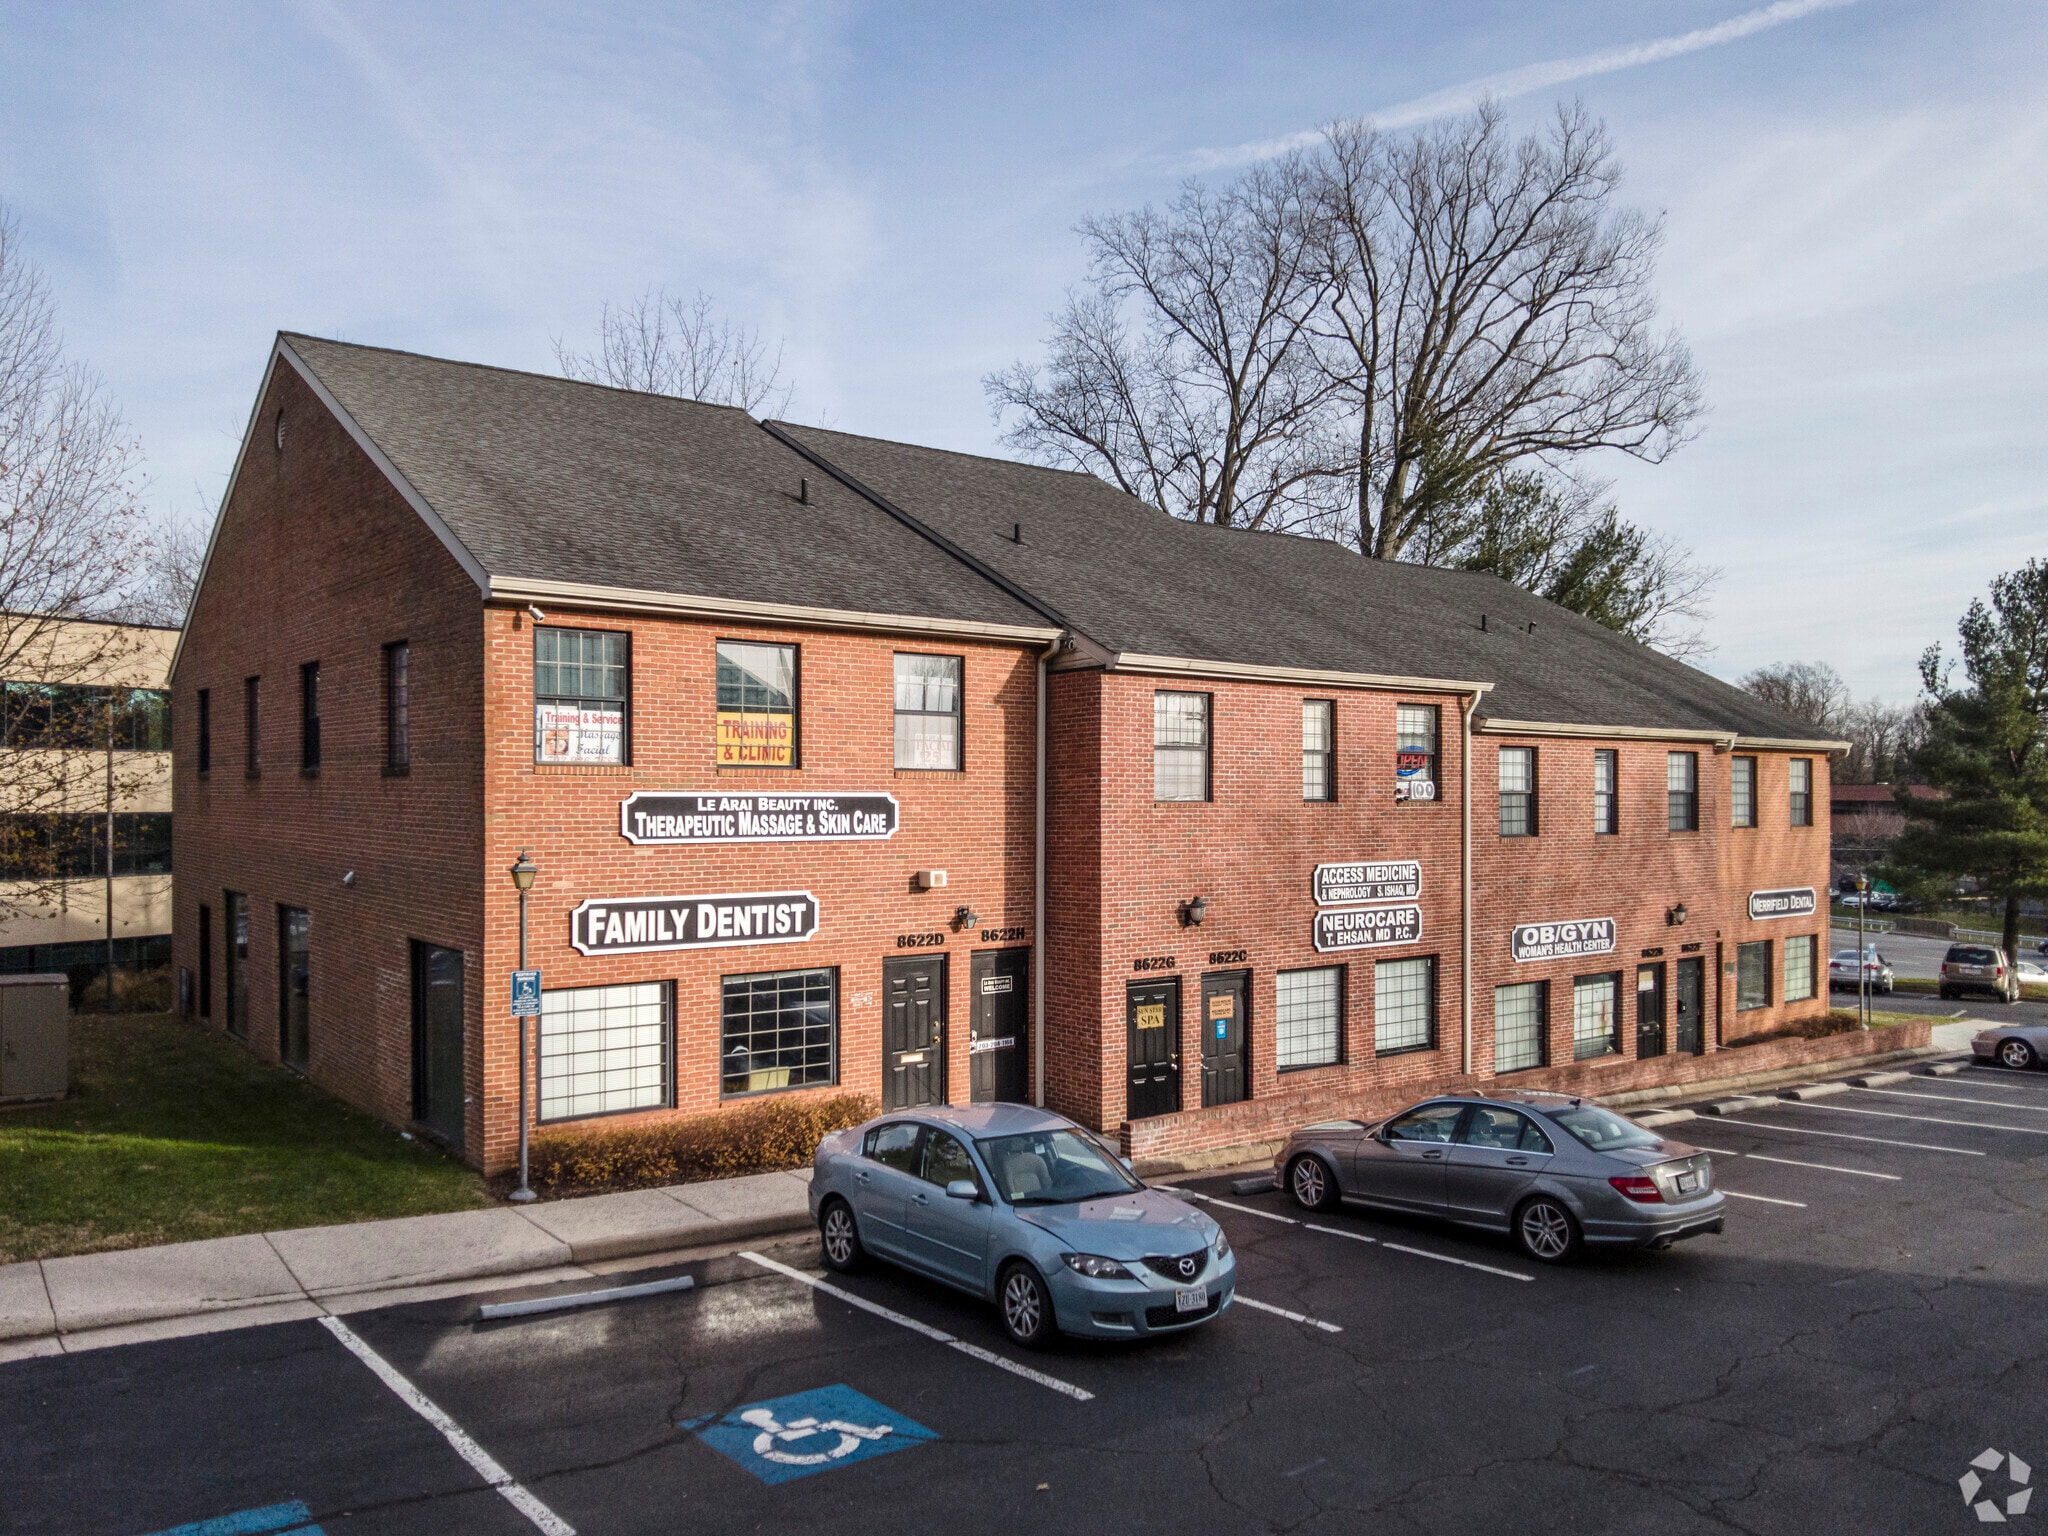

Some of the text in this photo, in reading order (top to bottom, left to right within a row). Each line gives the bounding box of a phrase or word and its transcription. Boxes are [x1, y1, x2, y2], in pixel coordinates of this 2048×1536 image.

[545, 712, 580, 726] Training
[583, 713, 589, 723] &
[723, 720, 787, 739] TRAINING
[724, 743, 785, 761] & CLINIC
[719, 797, 753, 811] ARAI
[758, 797, 811, 811] BEAUTY
[635, 809, 887, 837] THERAPEUTIC MASSAGE & SKIN CARE
[1321, 865, 1416, 885] ACCESS MEDICINE
[1321, 889, 1327, 900] &
[1328, 886, 1371, 900] NEPHROLOGY
[1377, 886, 1383, 897] S.
[1406, 884, 1416, 895] MD
[1753, 895, 1813, 912] MERRIFIELD DENTAL
[588, 903, 807, 945] FAMILY DENTIST
[1322, 910, 1415, 931] NEUROCARE
[897, 933, 945, 948] 8622D
[981, 927, 1025, 942] 8622H
[1326, 933, 1335, 945] T.
[1375, 928, 1391, 940] MD
[1395, 926, 1412, 939] P.C.
[1522, 922, 1607, 945] OB/GYN
[1518, 938, 1610, 958] WOMAN'S HEALTH CENTER
[1134, 956, 1176, 971] 8622G
[1209, 950, 1247, 965] 8622C
[984, 984, 1010, 992] WELCOME
[1141, 1015, 1160, 1025] SPA
